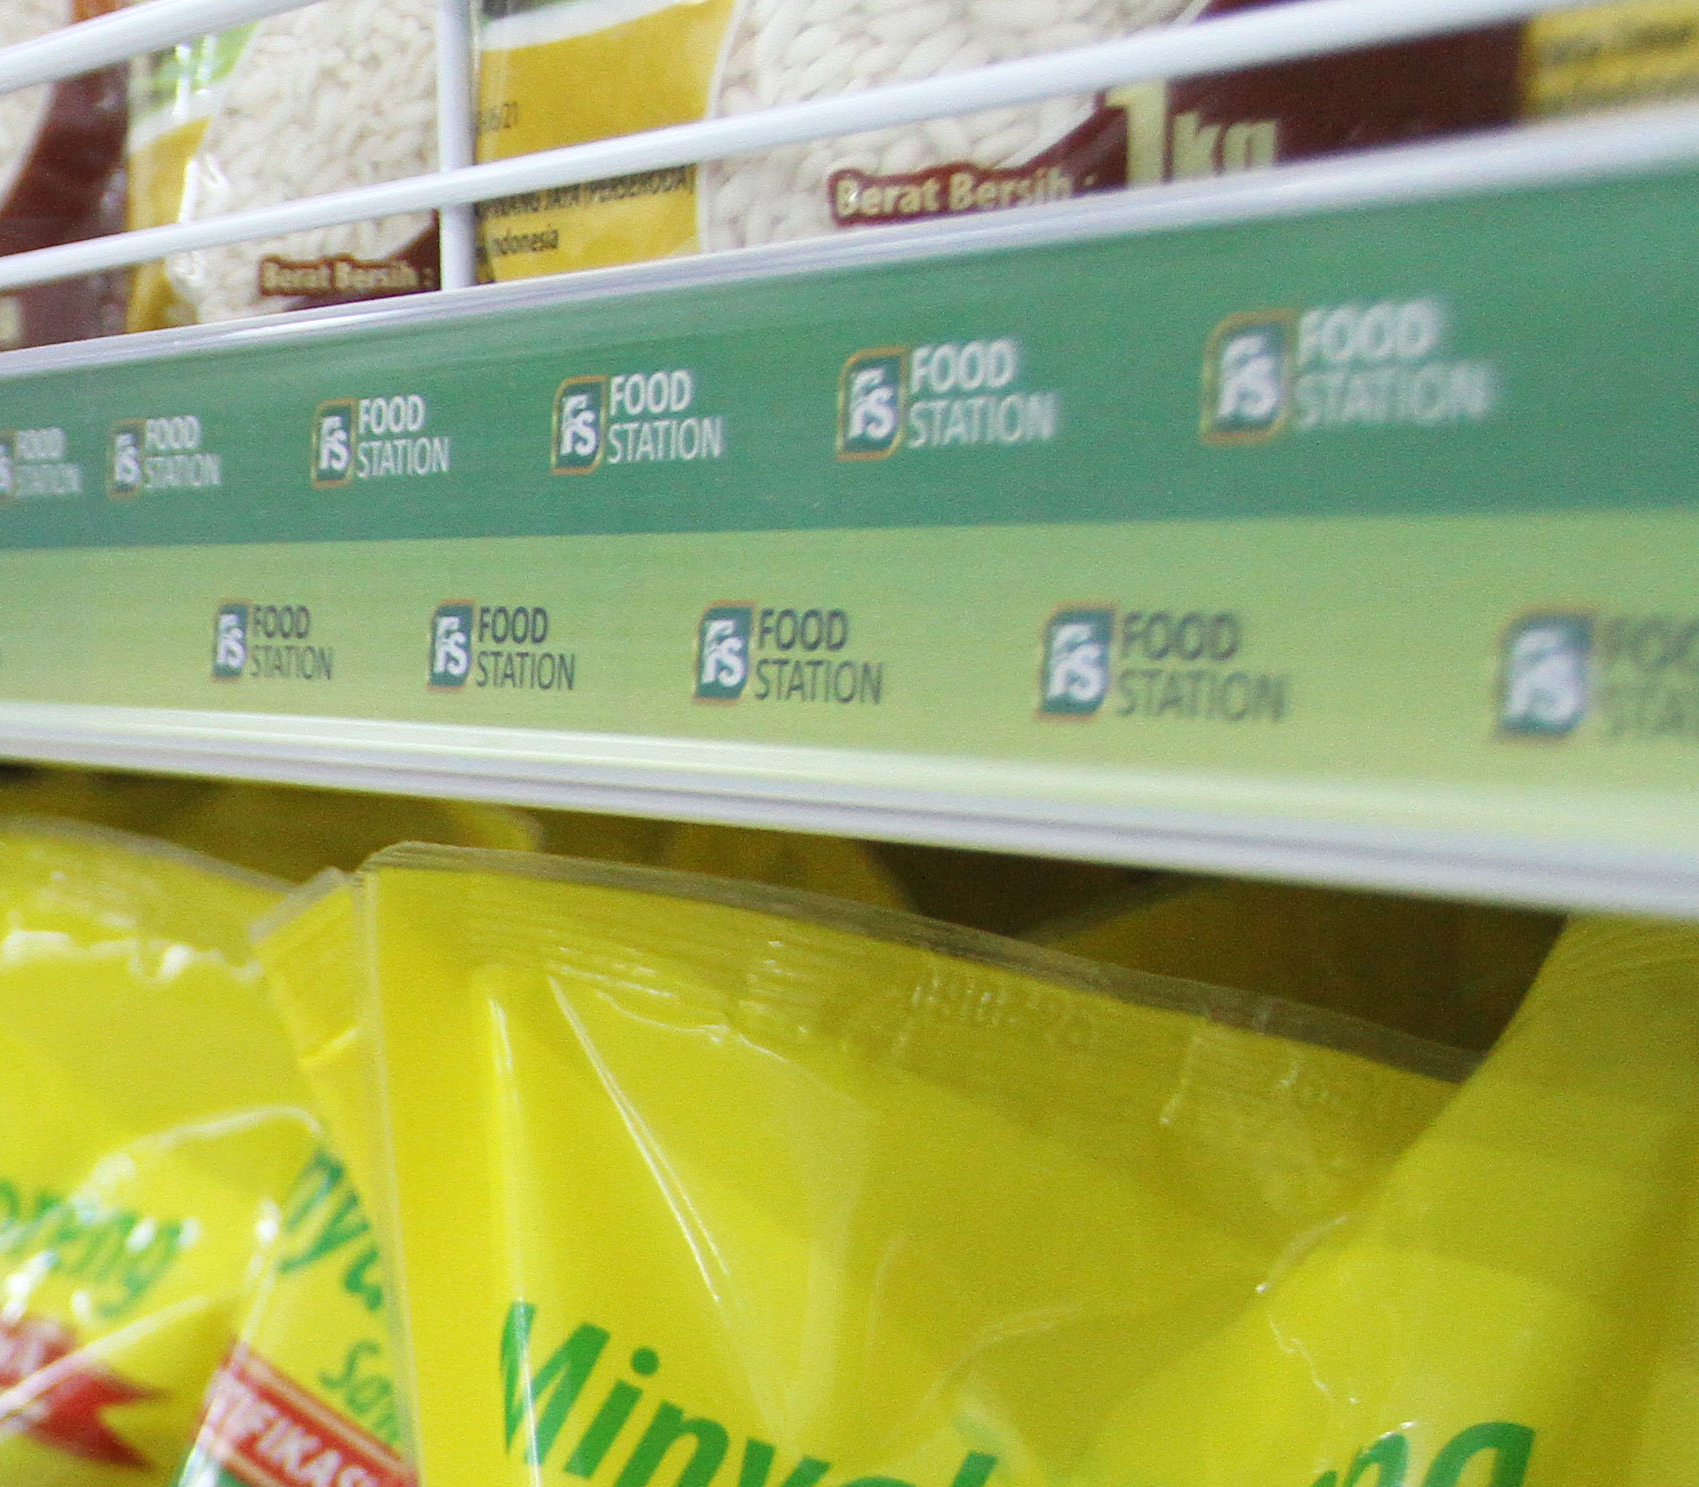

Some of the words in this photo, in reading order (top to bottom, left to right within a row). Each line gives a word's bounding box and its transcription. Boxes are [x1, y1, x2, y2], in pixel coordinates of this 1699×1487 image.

[834, 175, 940, 218] Berat
[948, 166, 1073, 213] Bersih
[1297, 299, 1444, 364] FOOD
[909, 339, 1019, 393] FOOD
[358, 395, 425, 431] FOOD
[609, 370, 693, 413] FOOD
[1295, 361, 1495, 430] STATION
[145, 415, 201, 451] FOOD
[607, 416, 724, 465] STATION
[907, 392, 1058, 450] STATION
[356, 435, 451, 479] STATION
[252, 604, 311, 640] FOOD
[477, 605, 549, 645] FOOD
[756, 608, 850, 650] FOOD
[1120, 611, 1244, 662] FOOD
[249, 644, 333, 682] STATION
[476, 649, 576, 692] STATION
[754, 658, 884, 704] STATION
[1115, 668, 1291, 724] STATION
